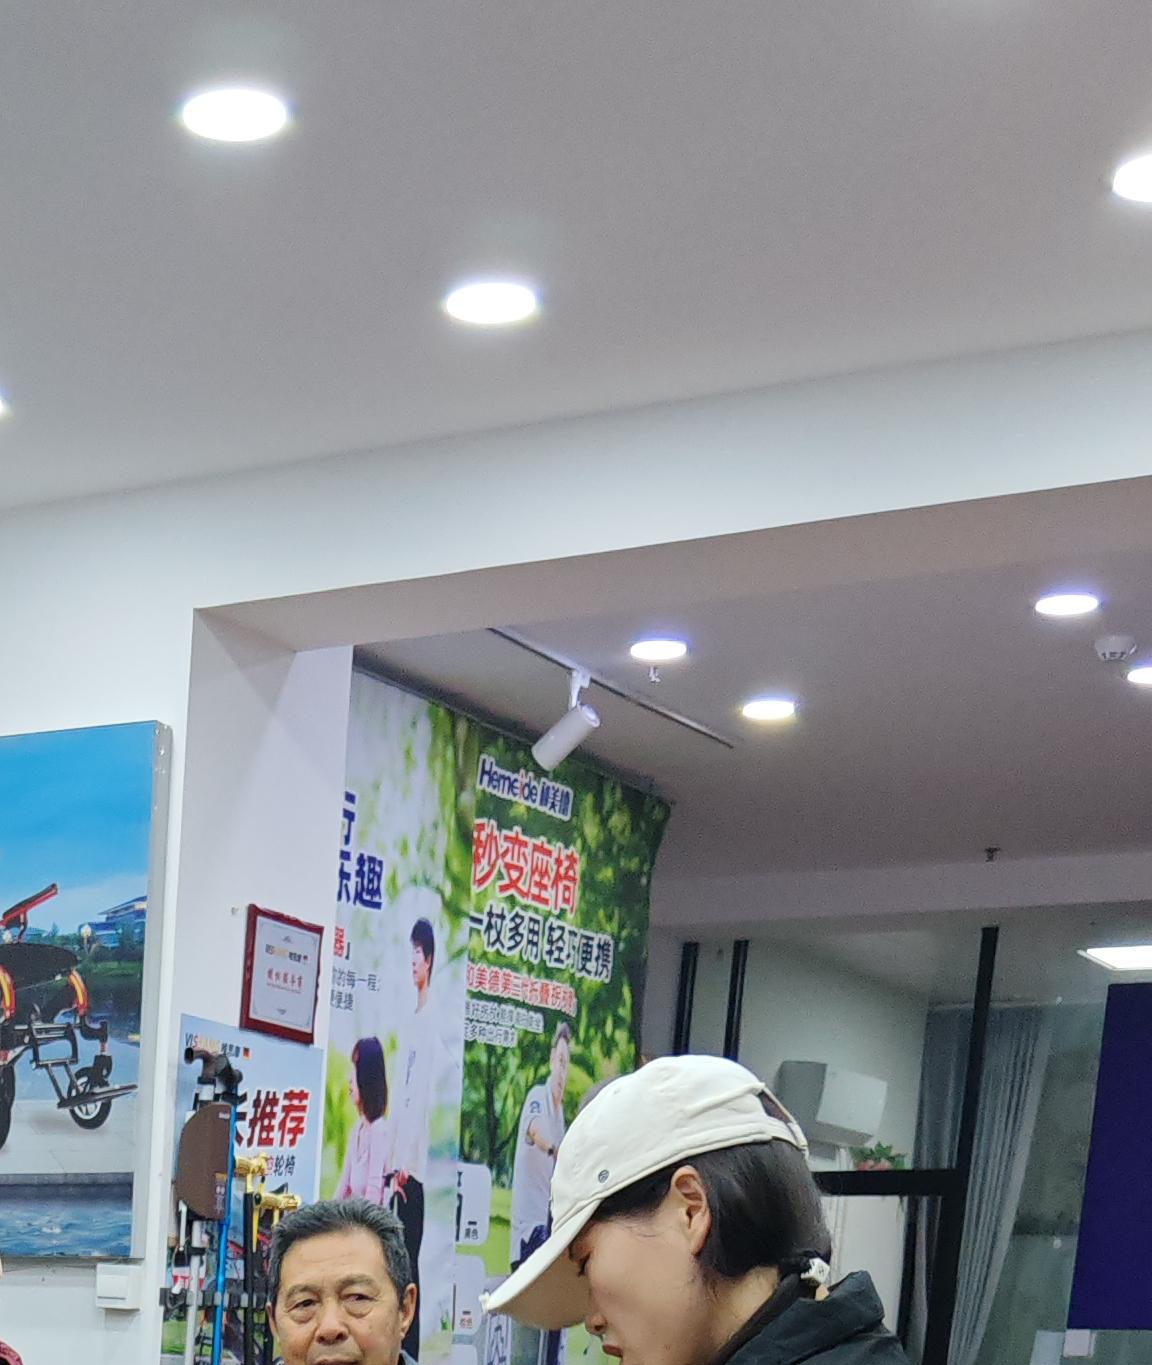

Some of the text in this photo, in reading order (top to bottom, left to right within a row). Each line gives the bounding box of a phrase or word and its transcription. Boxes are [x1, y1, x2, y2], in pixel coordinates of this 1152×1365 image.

[479, 758, 538, 804] Hemeide
[473, 822, 578, 915] 秒变座椅
